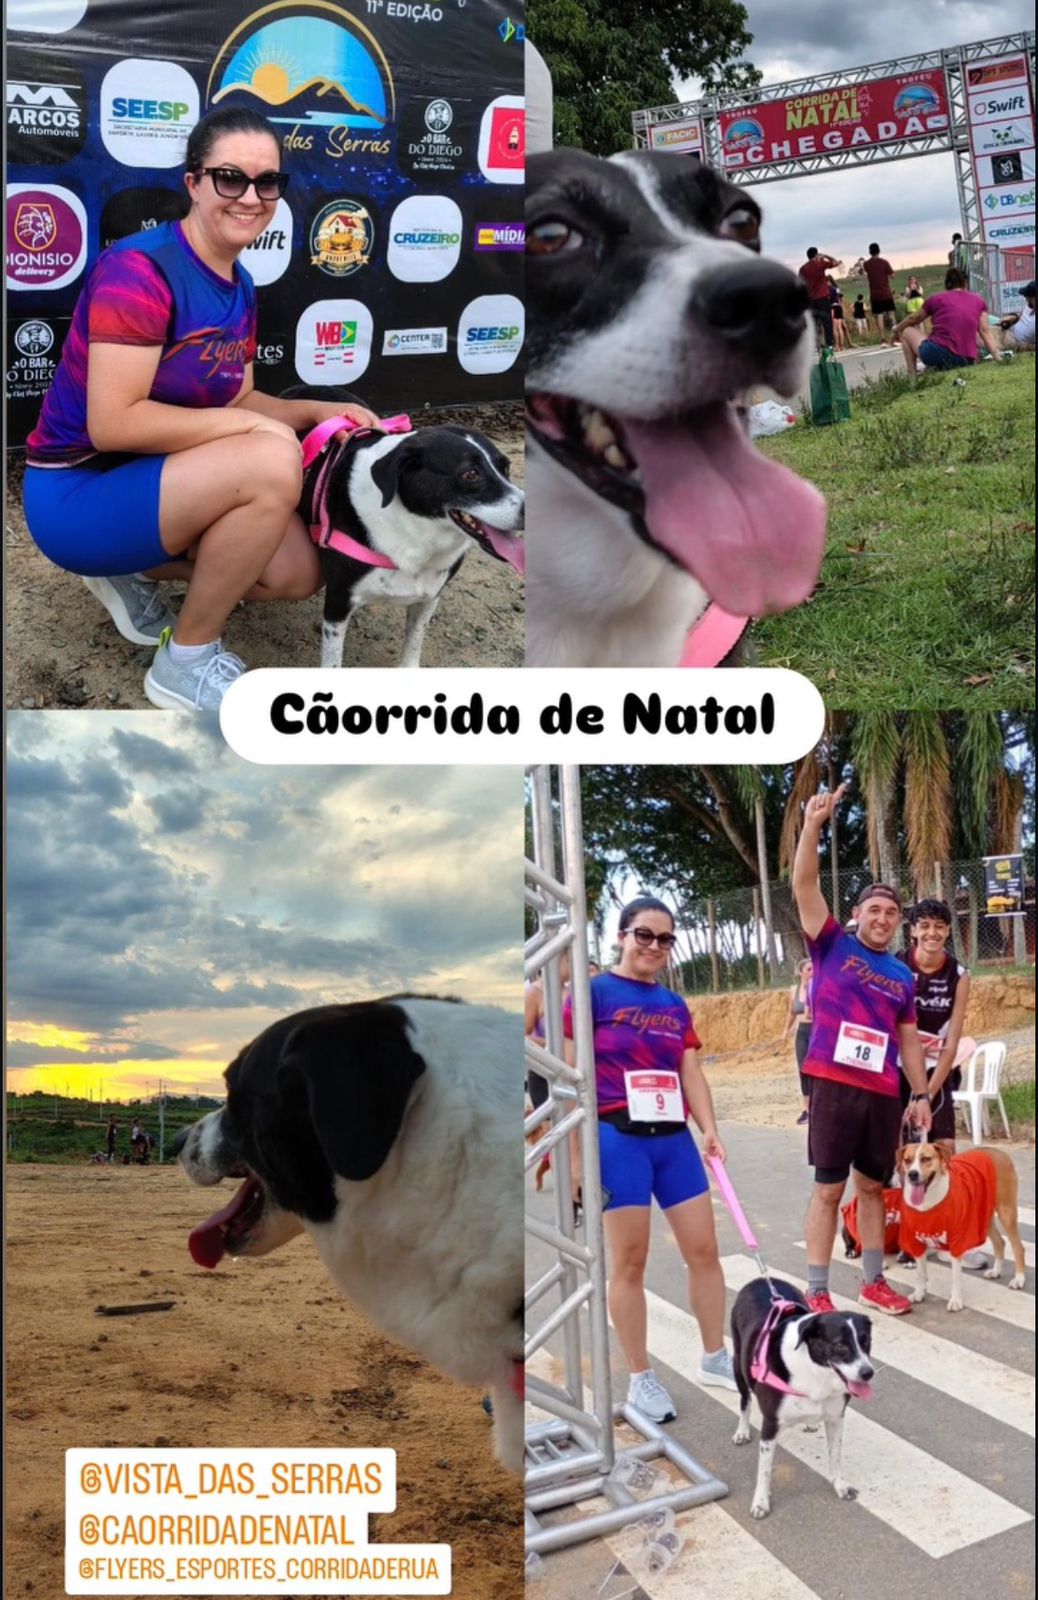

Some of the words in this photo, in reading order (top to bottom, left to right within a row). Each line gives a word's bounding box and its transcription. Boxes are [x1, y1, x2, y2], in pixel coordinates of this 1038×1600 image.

[387, 2, 443, 23] EDIÇÃO
[785, 93, 840, 111] CORRIDA
[842, 87, 857, 100] DE
[987, 96, 1025, 114] Swift
[8, 108, 80, 128] ARCOS
[112, 97, 189, 122] SEESP
[786, 98, 862, 131] NATAL
[18, 125, 79, 137] Automóveis
[746, 116, 925, 163] CHEGADA
[283, 123, 314, 151] das
[325, 124, 391, 158] Serras
[408, 143, 425, 155] DO
[428, 145, 462, 156] DIEGO
[246, 230, 286, 250] wift
[393, 232, 460, 245] CRUZEIRO
[989, 225, 1035, 238] CRUZEIR
[14, 267, 56, 278] delivery
[466, 325, 520, 342] SEESP
[29, 357, 48, 369] BAR
[6, 370, 18, 382] O
[840, 954, 905, 994] Flyers
[612, 1007, 681, 1035] Flyers
[855, 1044, 871, 1061] 18
[656, 1093, 665, 1110] 9
